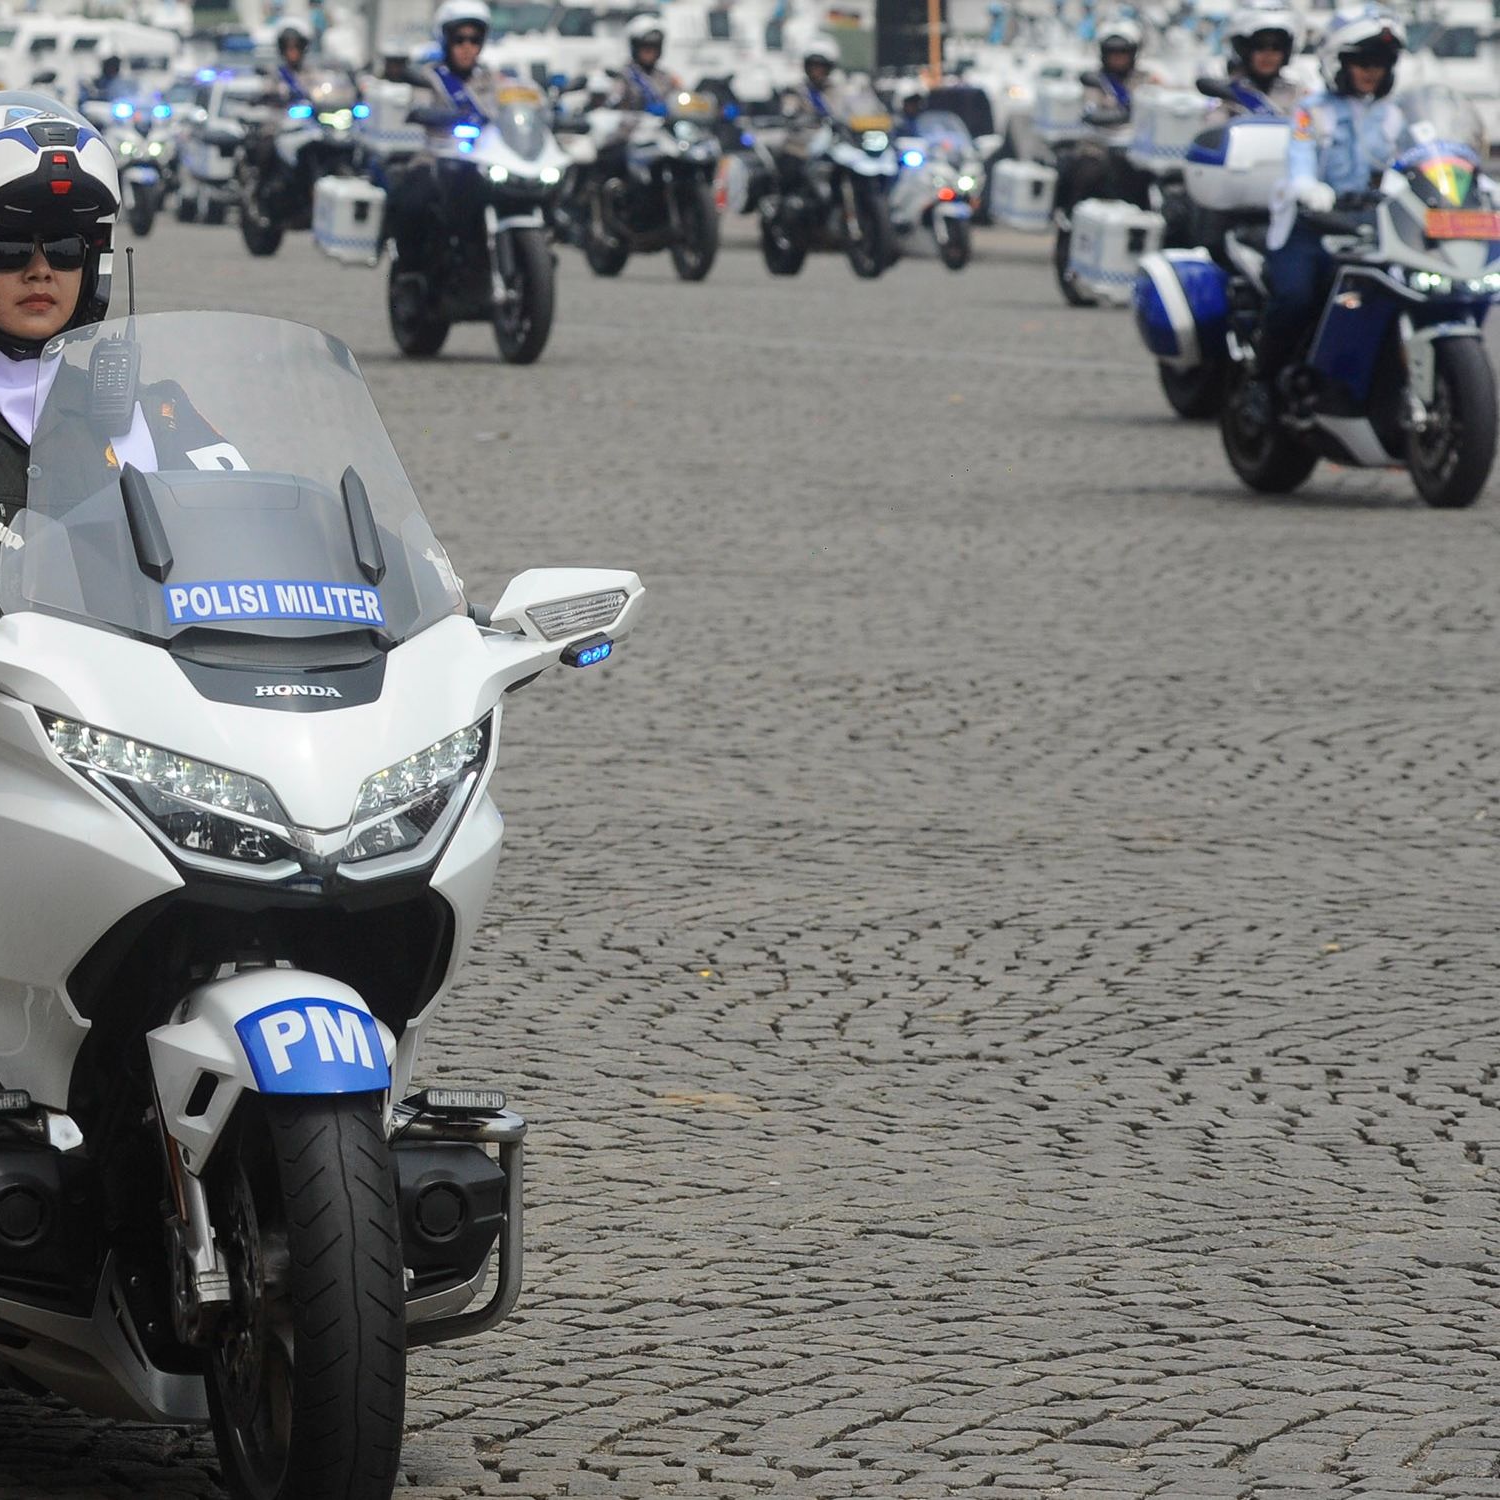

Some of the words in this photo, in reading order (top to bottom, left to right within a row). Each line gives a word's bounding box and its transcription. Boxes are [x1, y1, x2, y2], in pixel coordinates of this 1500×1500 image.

[169, 584, 269, 619] POLISI
[274, 585, 383, 622] MILITER
[254, 684, 343, 698] HONDA
[258, 1006, 375, 1075] PM
